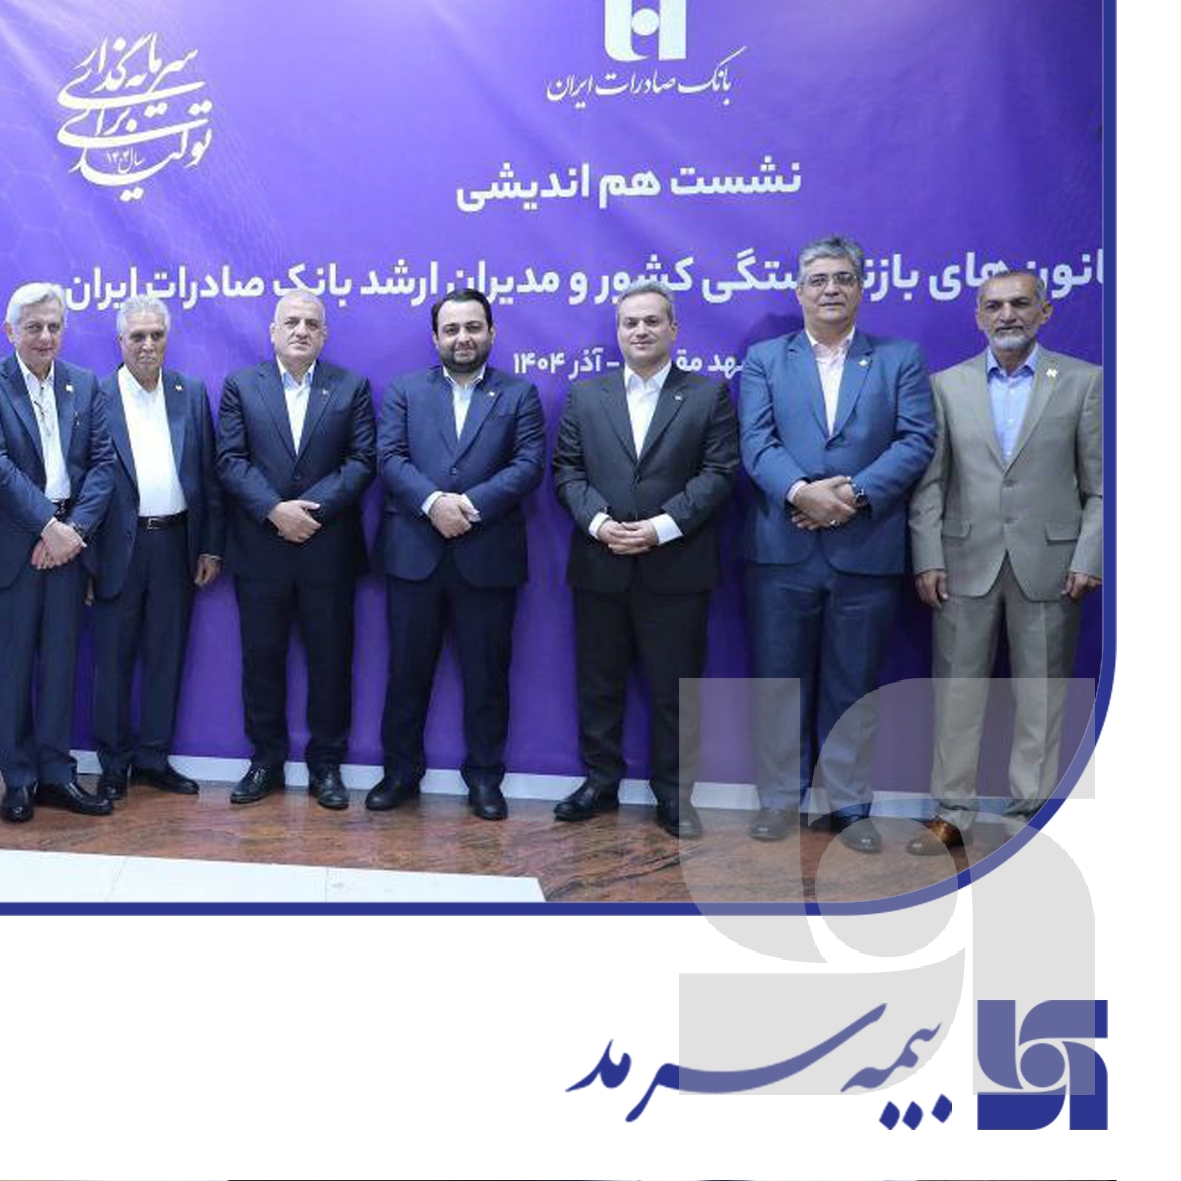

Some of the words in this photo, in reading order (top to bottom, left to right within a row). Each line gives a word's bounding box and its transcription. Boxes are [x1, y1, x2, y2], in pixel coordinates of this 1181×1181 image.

[547, 74, 593, 109] ایران
[595, 70, 676, 96] صادرات
[677, 46, 747, 106] بانک
[456, 161, 590, 212] اندیشی
[598, 170, 661, 210] هم
[670, 155, 802, 196] نشست
[66, 266, 138, 311] ایران
[146, 265, 265, 310] صادرات
[273, 263, 353, 307] بانک
[360, 259, 439, 306] ارشد
[569, 271, 588, 305] و
[513, 352, 566, 374] ۱۴۰۴
[568, 347, 604, 380] آذر
